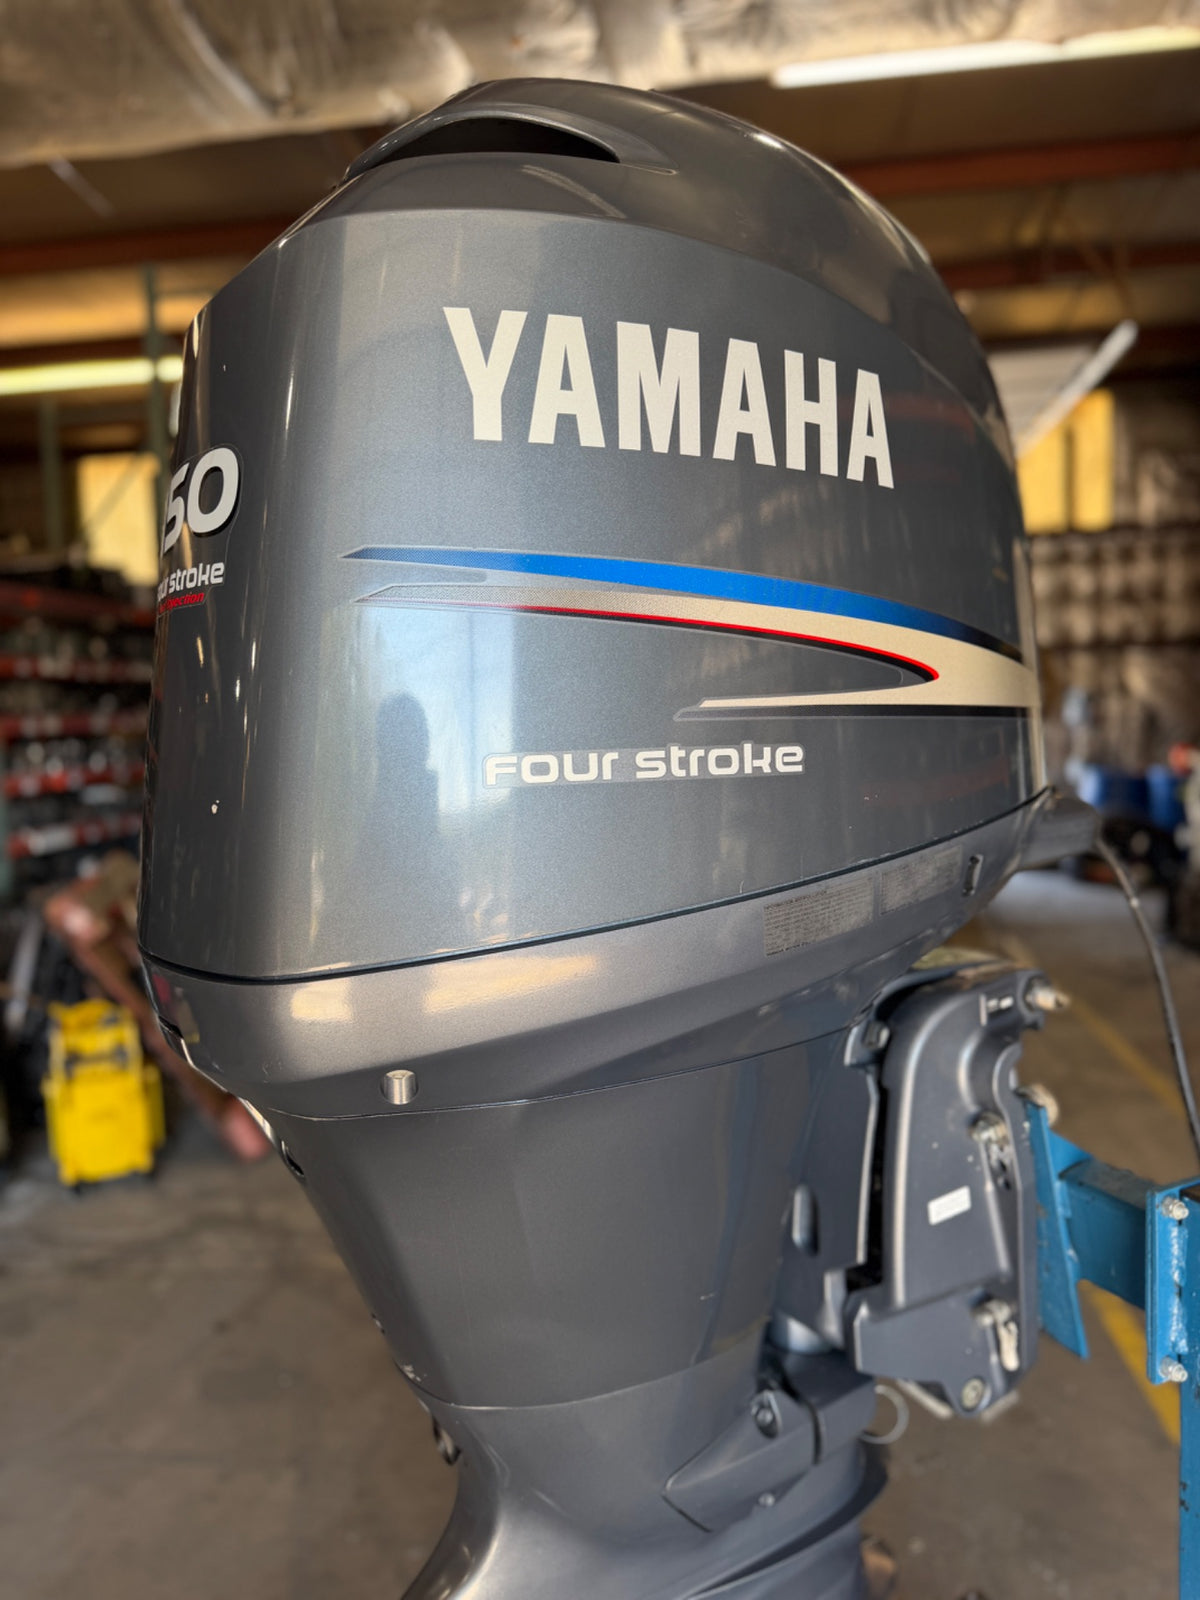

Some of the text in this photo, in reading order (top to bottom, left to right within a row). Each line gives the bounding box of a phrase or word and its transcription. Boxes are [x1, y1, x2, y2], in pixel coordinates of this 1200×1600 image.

[443, 307, 894, 489] YAMAHA
[160, 447, 239, 556] 50
[157, 562, 225, 601] our stroke
[635, 743, 803, 779] stroke
